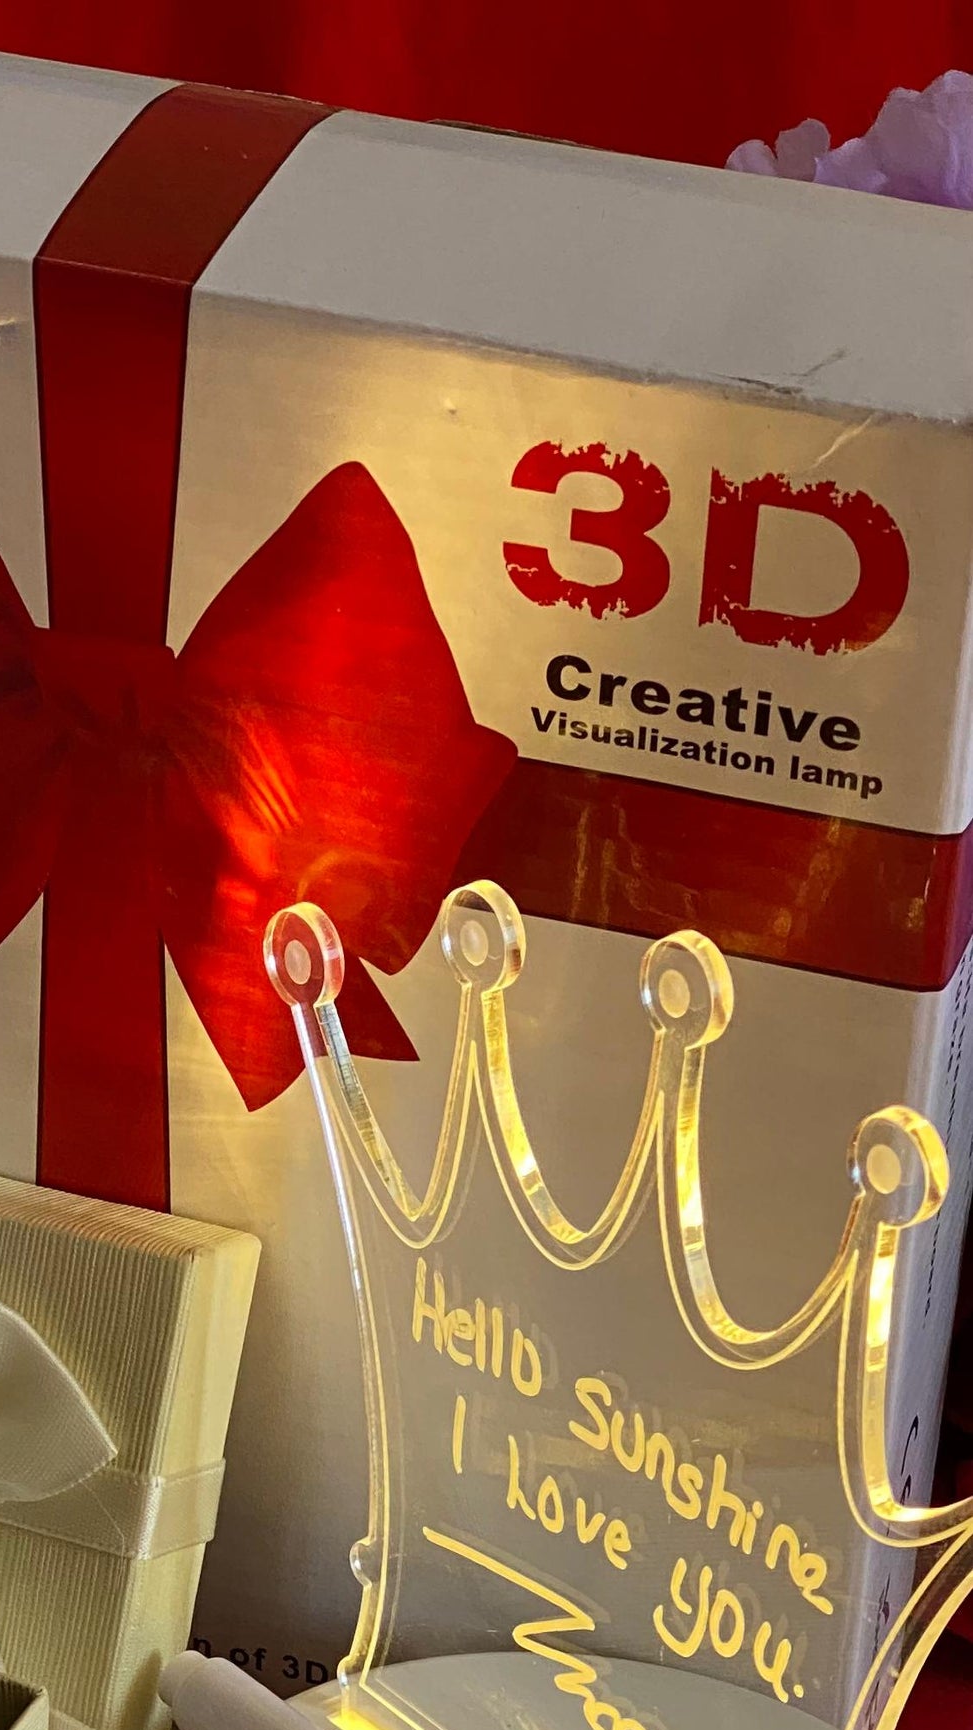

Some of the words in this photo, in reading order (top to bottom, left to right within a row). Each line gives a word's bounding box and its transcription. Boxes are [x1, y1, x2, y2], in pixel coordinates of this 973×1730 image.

[503, 441, 910, 656] 3D
[546, 654, 861, 752] Creative
[532, 706, 776, 776] Visualization
[789, 756, 883, 800] lamp
[412, 1257, 542, 1396] Hello
[569, 1377, 834, 1615] Sunshine
[452, 1395, 467, 1474] I
[229, 1648, 267, 1671] of
[282, 1655, 329, 1685] 3D
